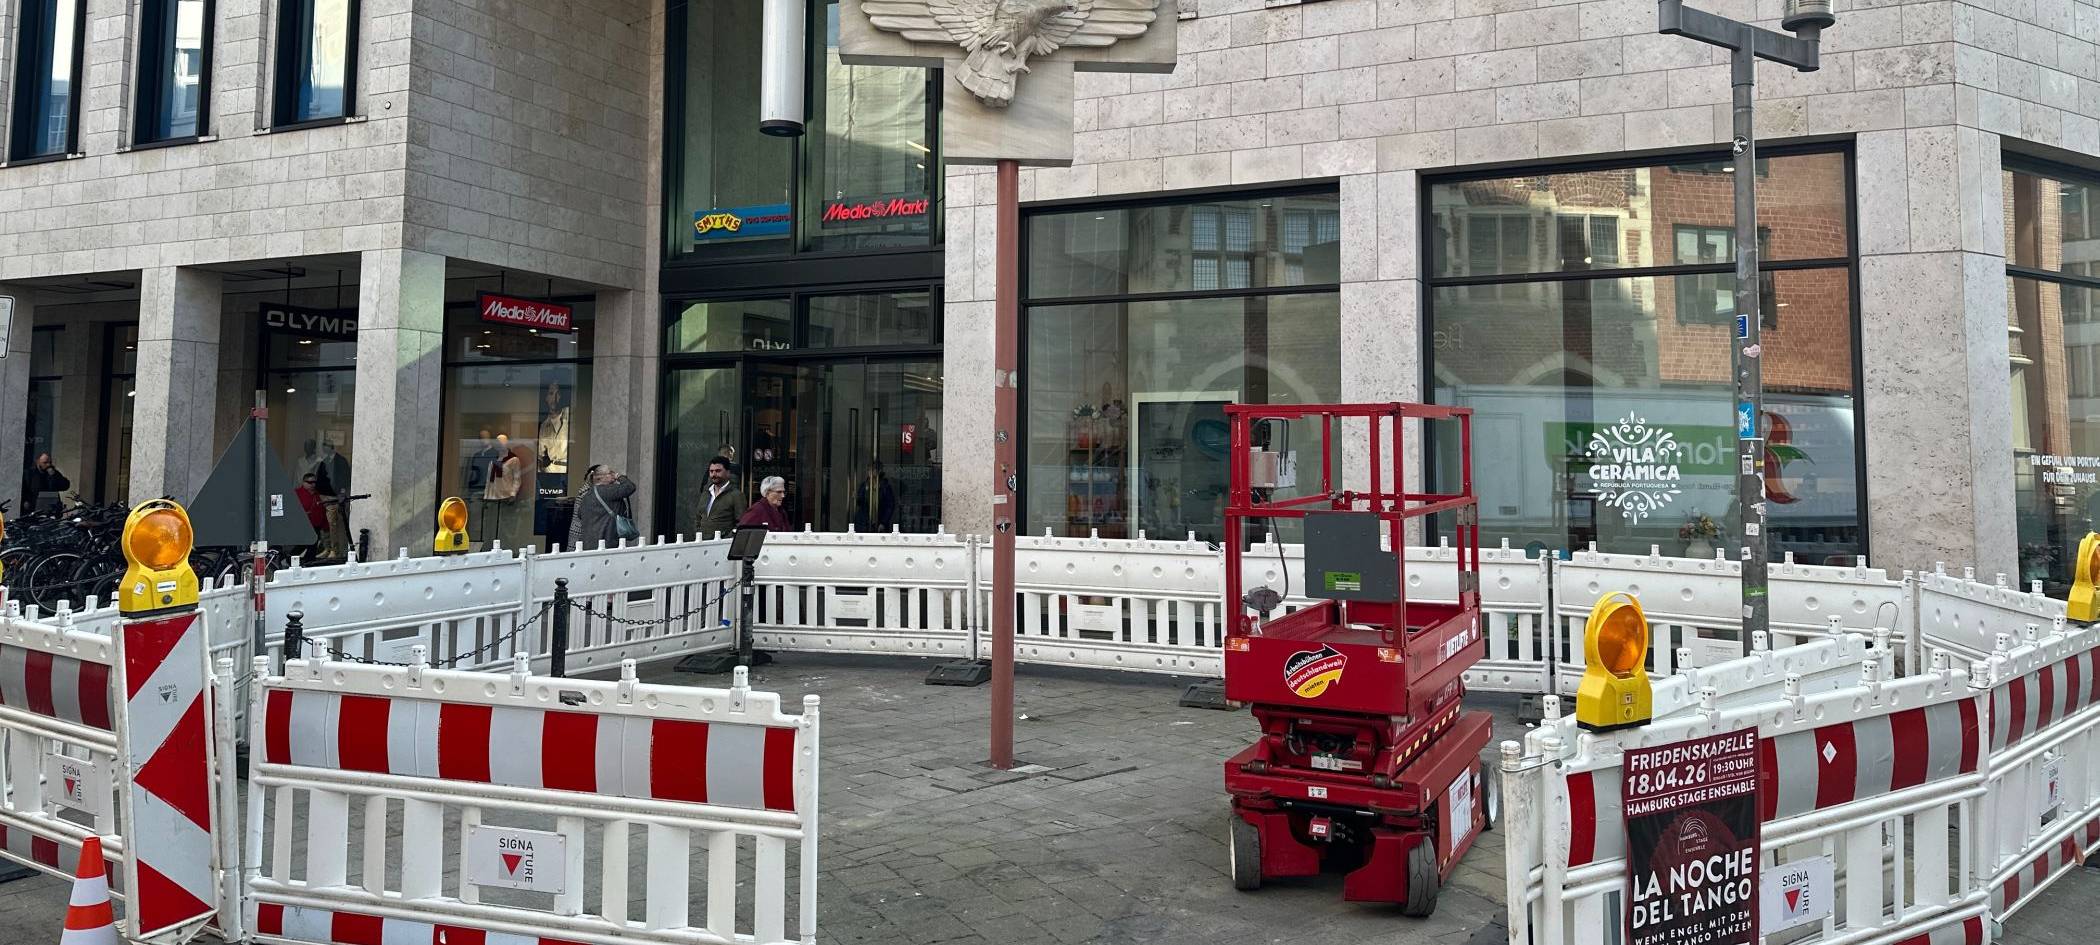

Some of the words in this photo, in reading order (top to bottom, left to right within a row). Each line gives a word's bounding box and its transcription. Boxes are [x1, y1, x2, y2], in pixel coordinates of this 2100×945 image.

[695, 213, 741, 233] SMYTHS
[266, 310, 358, 334] OLYMP
[1612, 447, 1655, 463] VILA
[2030, 455, 2041, 465] EIN
[2041, 453, 2062, 466] GEFÜHL
[2063, 455, 2077, 467] VON
[1588, 461, 1681, 480] CERÂMICA
[2043, 470, 2055, 482] FÜR
[2070, 472, 2096, 483] ZUHAUSE
[1286, 652, 1323, 676] Arbeitsbühnen
[1290, 658, 1343, 688] deutschlandweit
[1304, 680, 1325, 694] mieten
[1630, 732, 1755, 772] FRIEDENSKAPELLE
[1713, 760, 1735, 774] 19:30
[1735, 757, 1754, 770] UHR
[1628, 762, 1707, 796] 18.04.26
[1627, 795, 1677, 816] HAMBURG
[1678, 787, 1707, 806] STAGE
[1708, 779, 1756, 799] ENSEMBLE
[499, 837, 534, 851] SIGNA
[524, 852, 534, 883] TURE
[1633, 870, 1662, 902] LA
[1670, 847, 1753, 894] NOCHE
[1782, 870, 1809, 887] SIGNA
[1633, 898, 1674, 930] DEL
[1680, 878, 1752, 917] TANGO
[1802, 882, 1810, 916] TURE
[1635, 931, 1665, 945] WENN
[1670, 922, 1704, 938] ENGEL
[1709, 916, 1726, 928] MIT
[1730, 910, 1750, 922] DEM
[1676, 933, 1712, 945] TANGO
[1716, 920, 1752, 938] TANZEN
